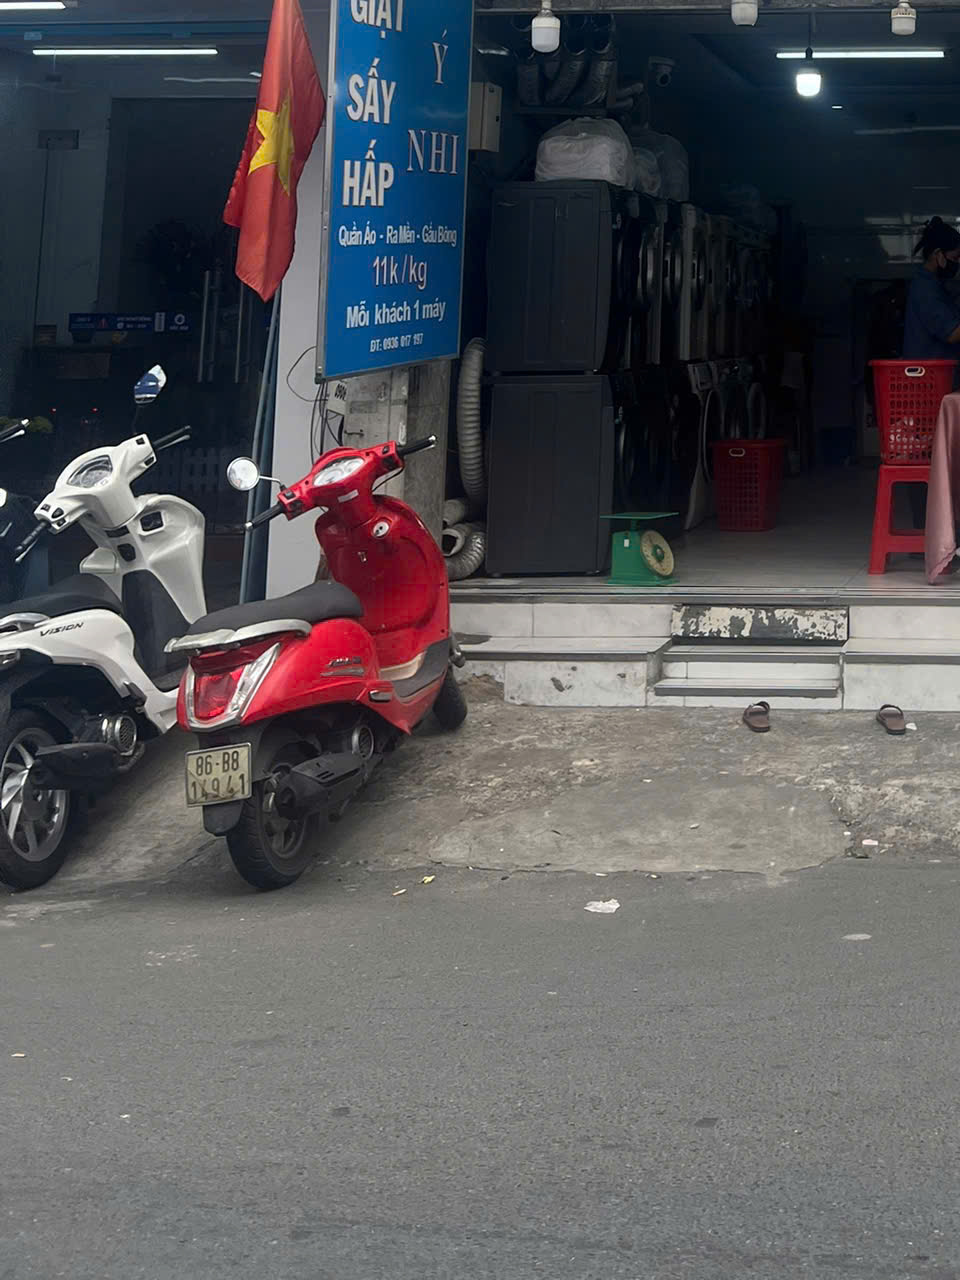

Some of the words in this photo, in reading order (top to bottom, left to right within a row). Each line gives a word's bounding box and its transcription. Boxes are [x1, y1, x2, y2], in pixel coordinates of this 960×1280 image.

[432, 28, 449, 85] Ý
[346, 56, 397, 124] SẤY
[342, 139, 395, 206] HẤP
[407, 129, 460, 174] NHI
[374, 301, 411, 325] khách
[413, 300, 420, 320] 1
[422, 298, 446, 321] máy
[40, 622, 84, 637] VISION
[196, 751, 240, 776] 86-B8
